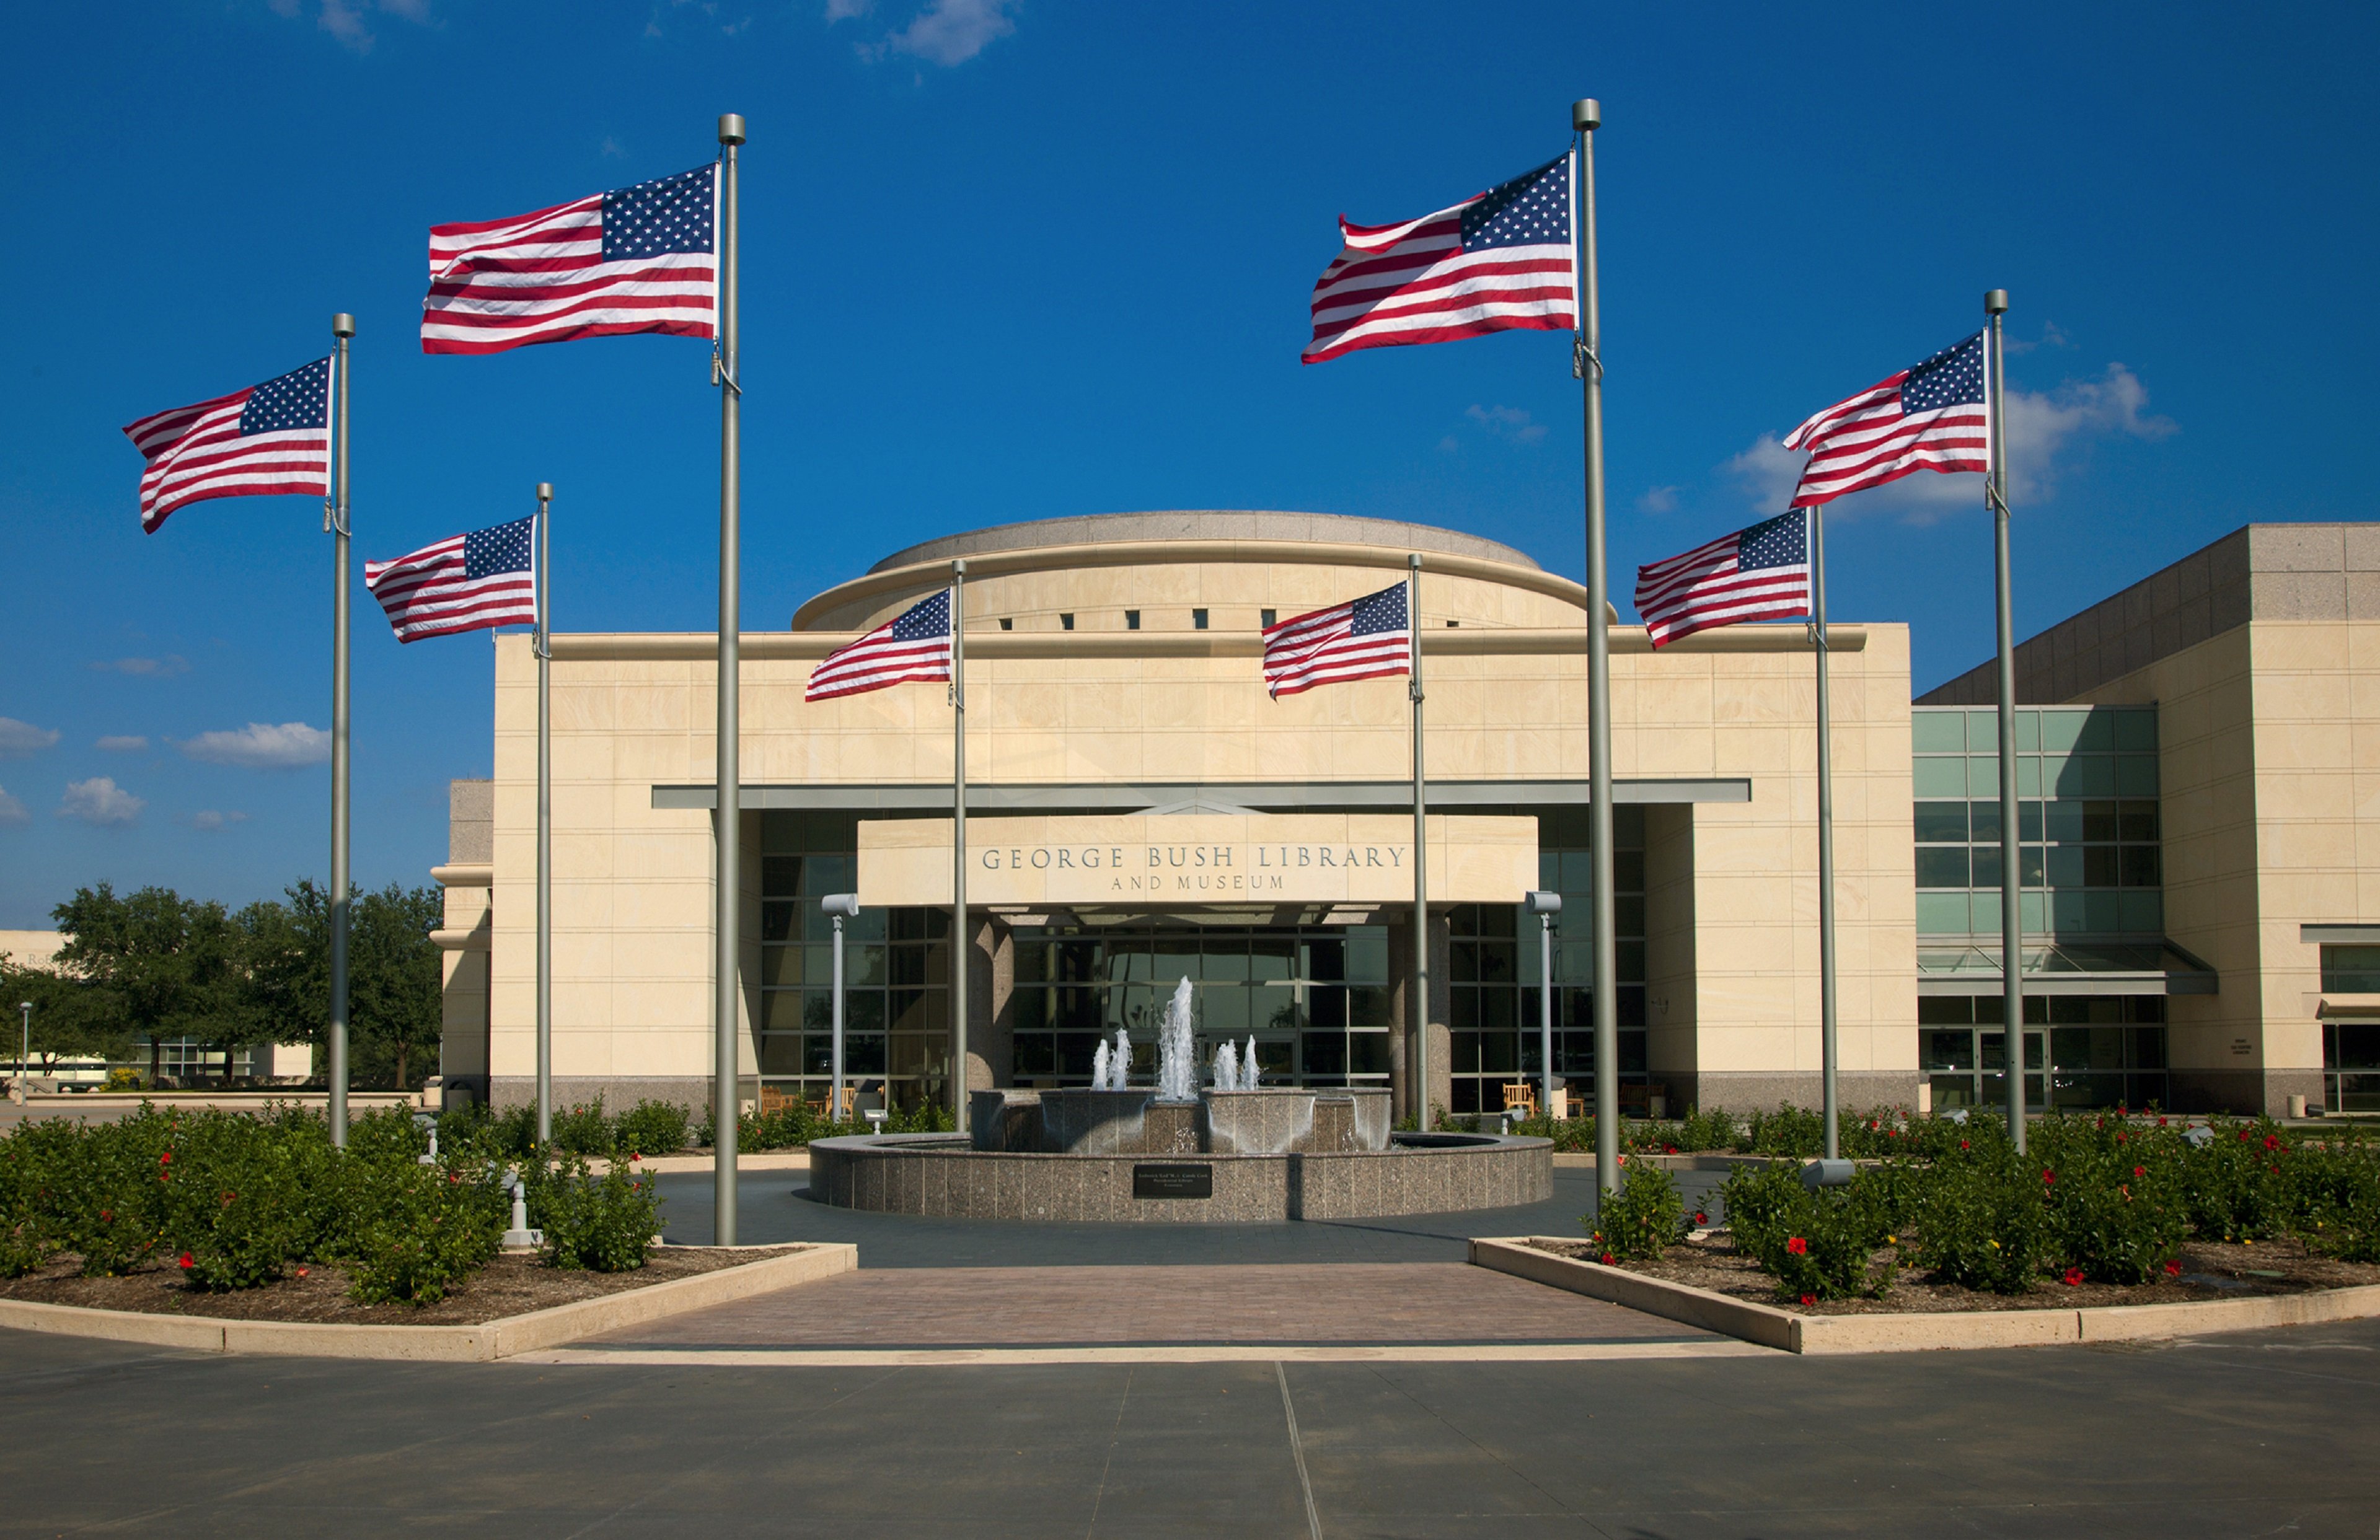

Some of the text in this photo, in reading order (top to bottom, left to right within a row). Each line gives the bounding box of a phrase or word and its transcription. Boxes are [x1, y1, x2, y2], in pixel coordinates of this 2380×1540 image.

[982, 847, 1405, 869] GEORGE BUSH LIBRARY
[1111, 874, 1283, 890] AND MUSEUM
